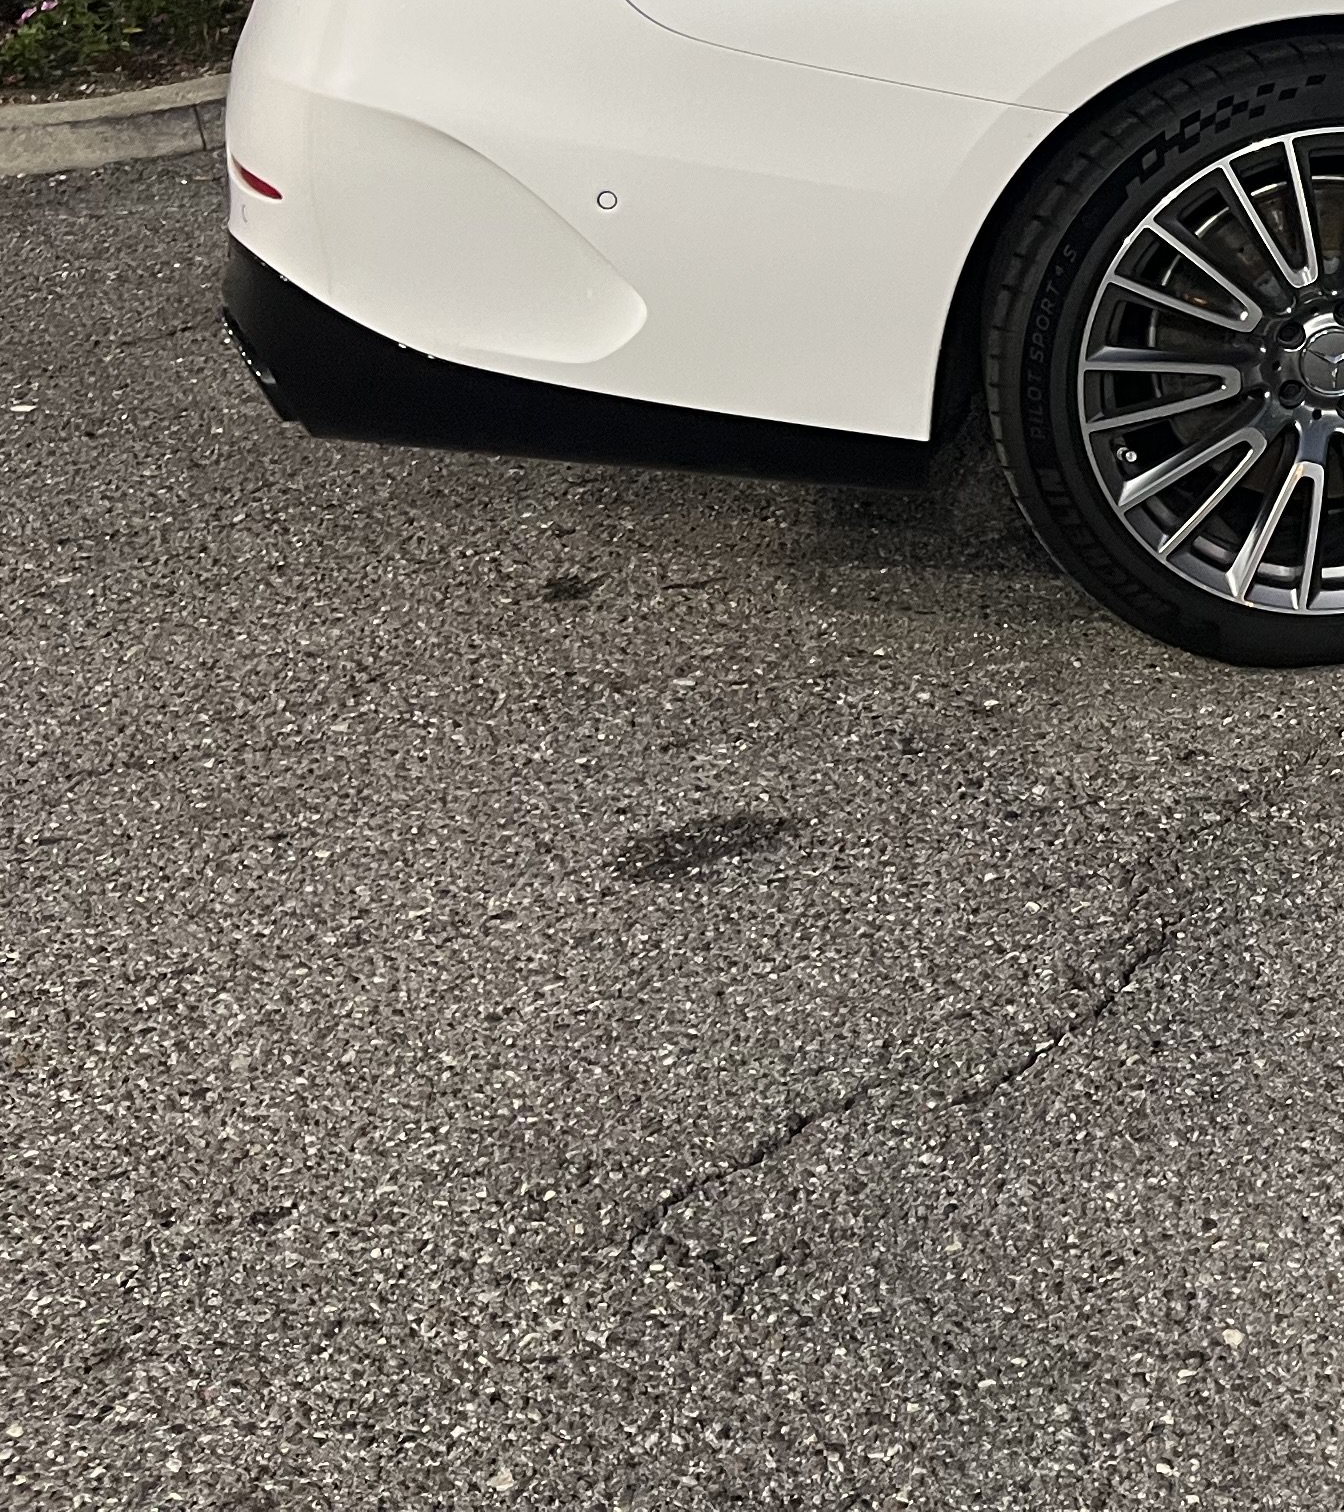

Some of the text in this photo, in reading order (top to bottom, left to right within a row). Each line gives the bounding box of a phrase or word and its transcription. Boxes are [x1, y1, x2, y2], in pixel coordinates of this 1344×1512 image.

[1059, 242, 1080, 263] S
[1028, 279, 1063, 363] SPORT
[1026, 368, 1049, 441] PILOT
